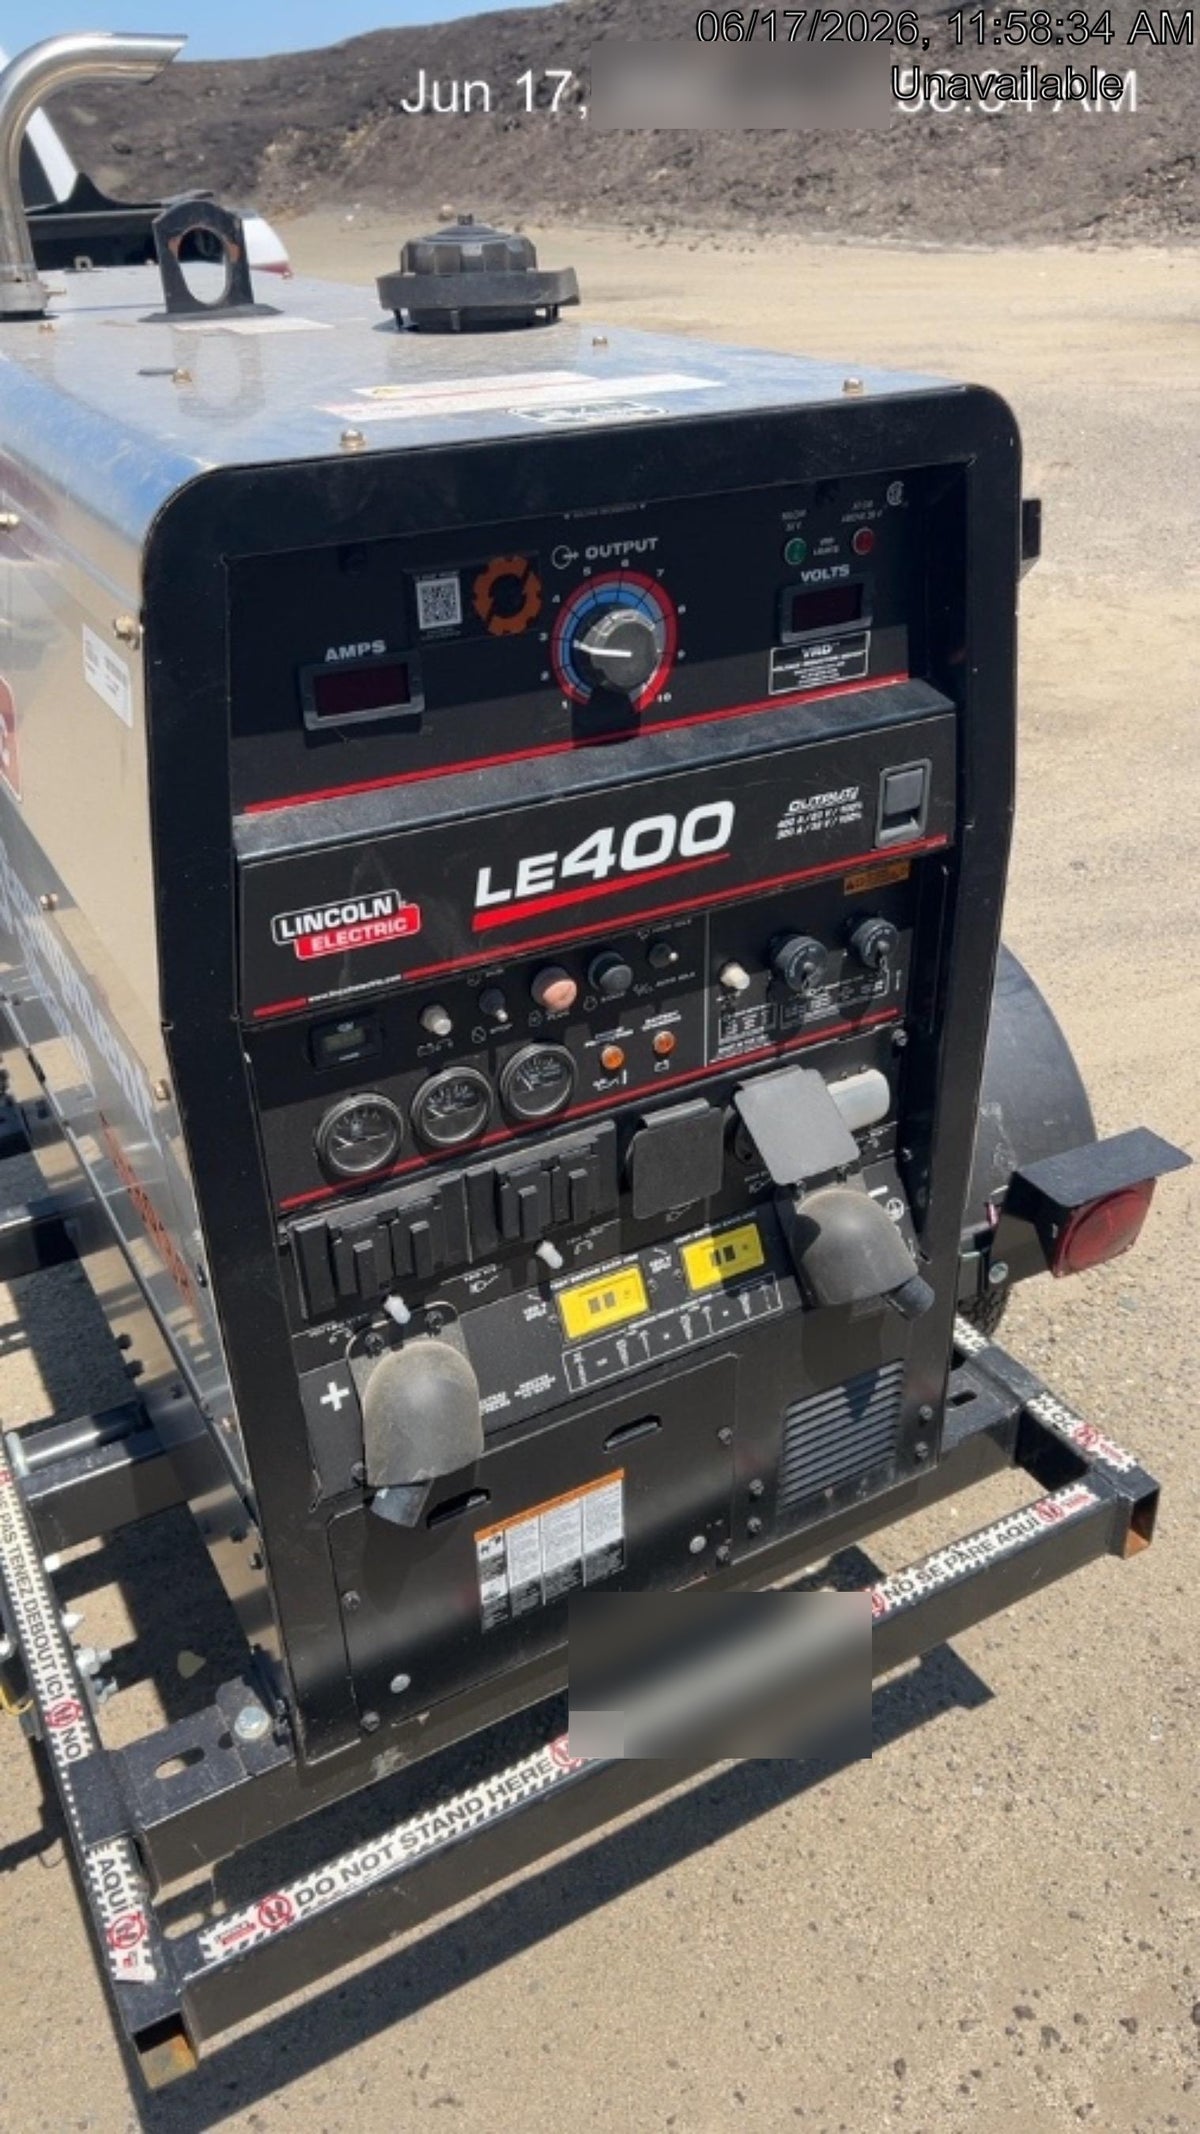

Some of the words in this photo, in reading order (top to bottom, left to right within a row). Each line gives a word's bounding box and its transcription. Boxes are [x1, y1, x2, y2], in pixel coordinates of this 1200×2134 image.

[584, 537, 659, 560] OUTPUT
[800, 563, 850, 583] VOLTS
[324, 639, 387, 663] AMPS
[474, 800, 735, 908] LE400
[279, 895, 394, 939] LINCOLN
[310, 916, 408, 952] ELECTRIC
[883, 1578, 915, 1601] NO
[916, 1564, 946, 1584] SE
[943, 1538, 995, 1571] PARE
[8, 1543, 34, 1599] TENEZ
[23, 1598, 58, 1671] DEBOUT
[45, 1674, 65, 1701] ICI
[60, 1726, 83, 1760] NO
[294, 1877, 336, 1907] DO
[340, 1842, 396, 1884] NOT
[398, 1799, 485, 1851] STAND
[484, 1755, 551, 1802] HERE
